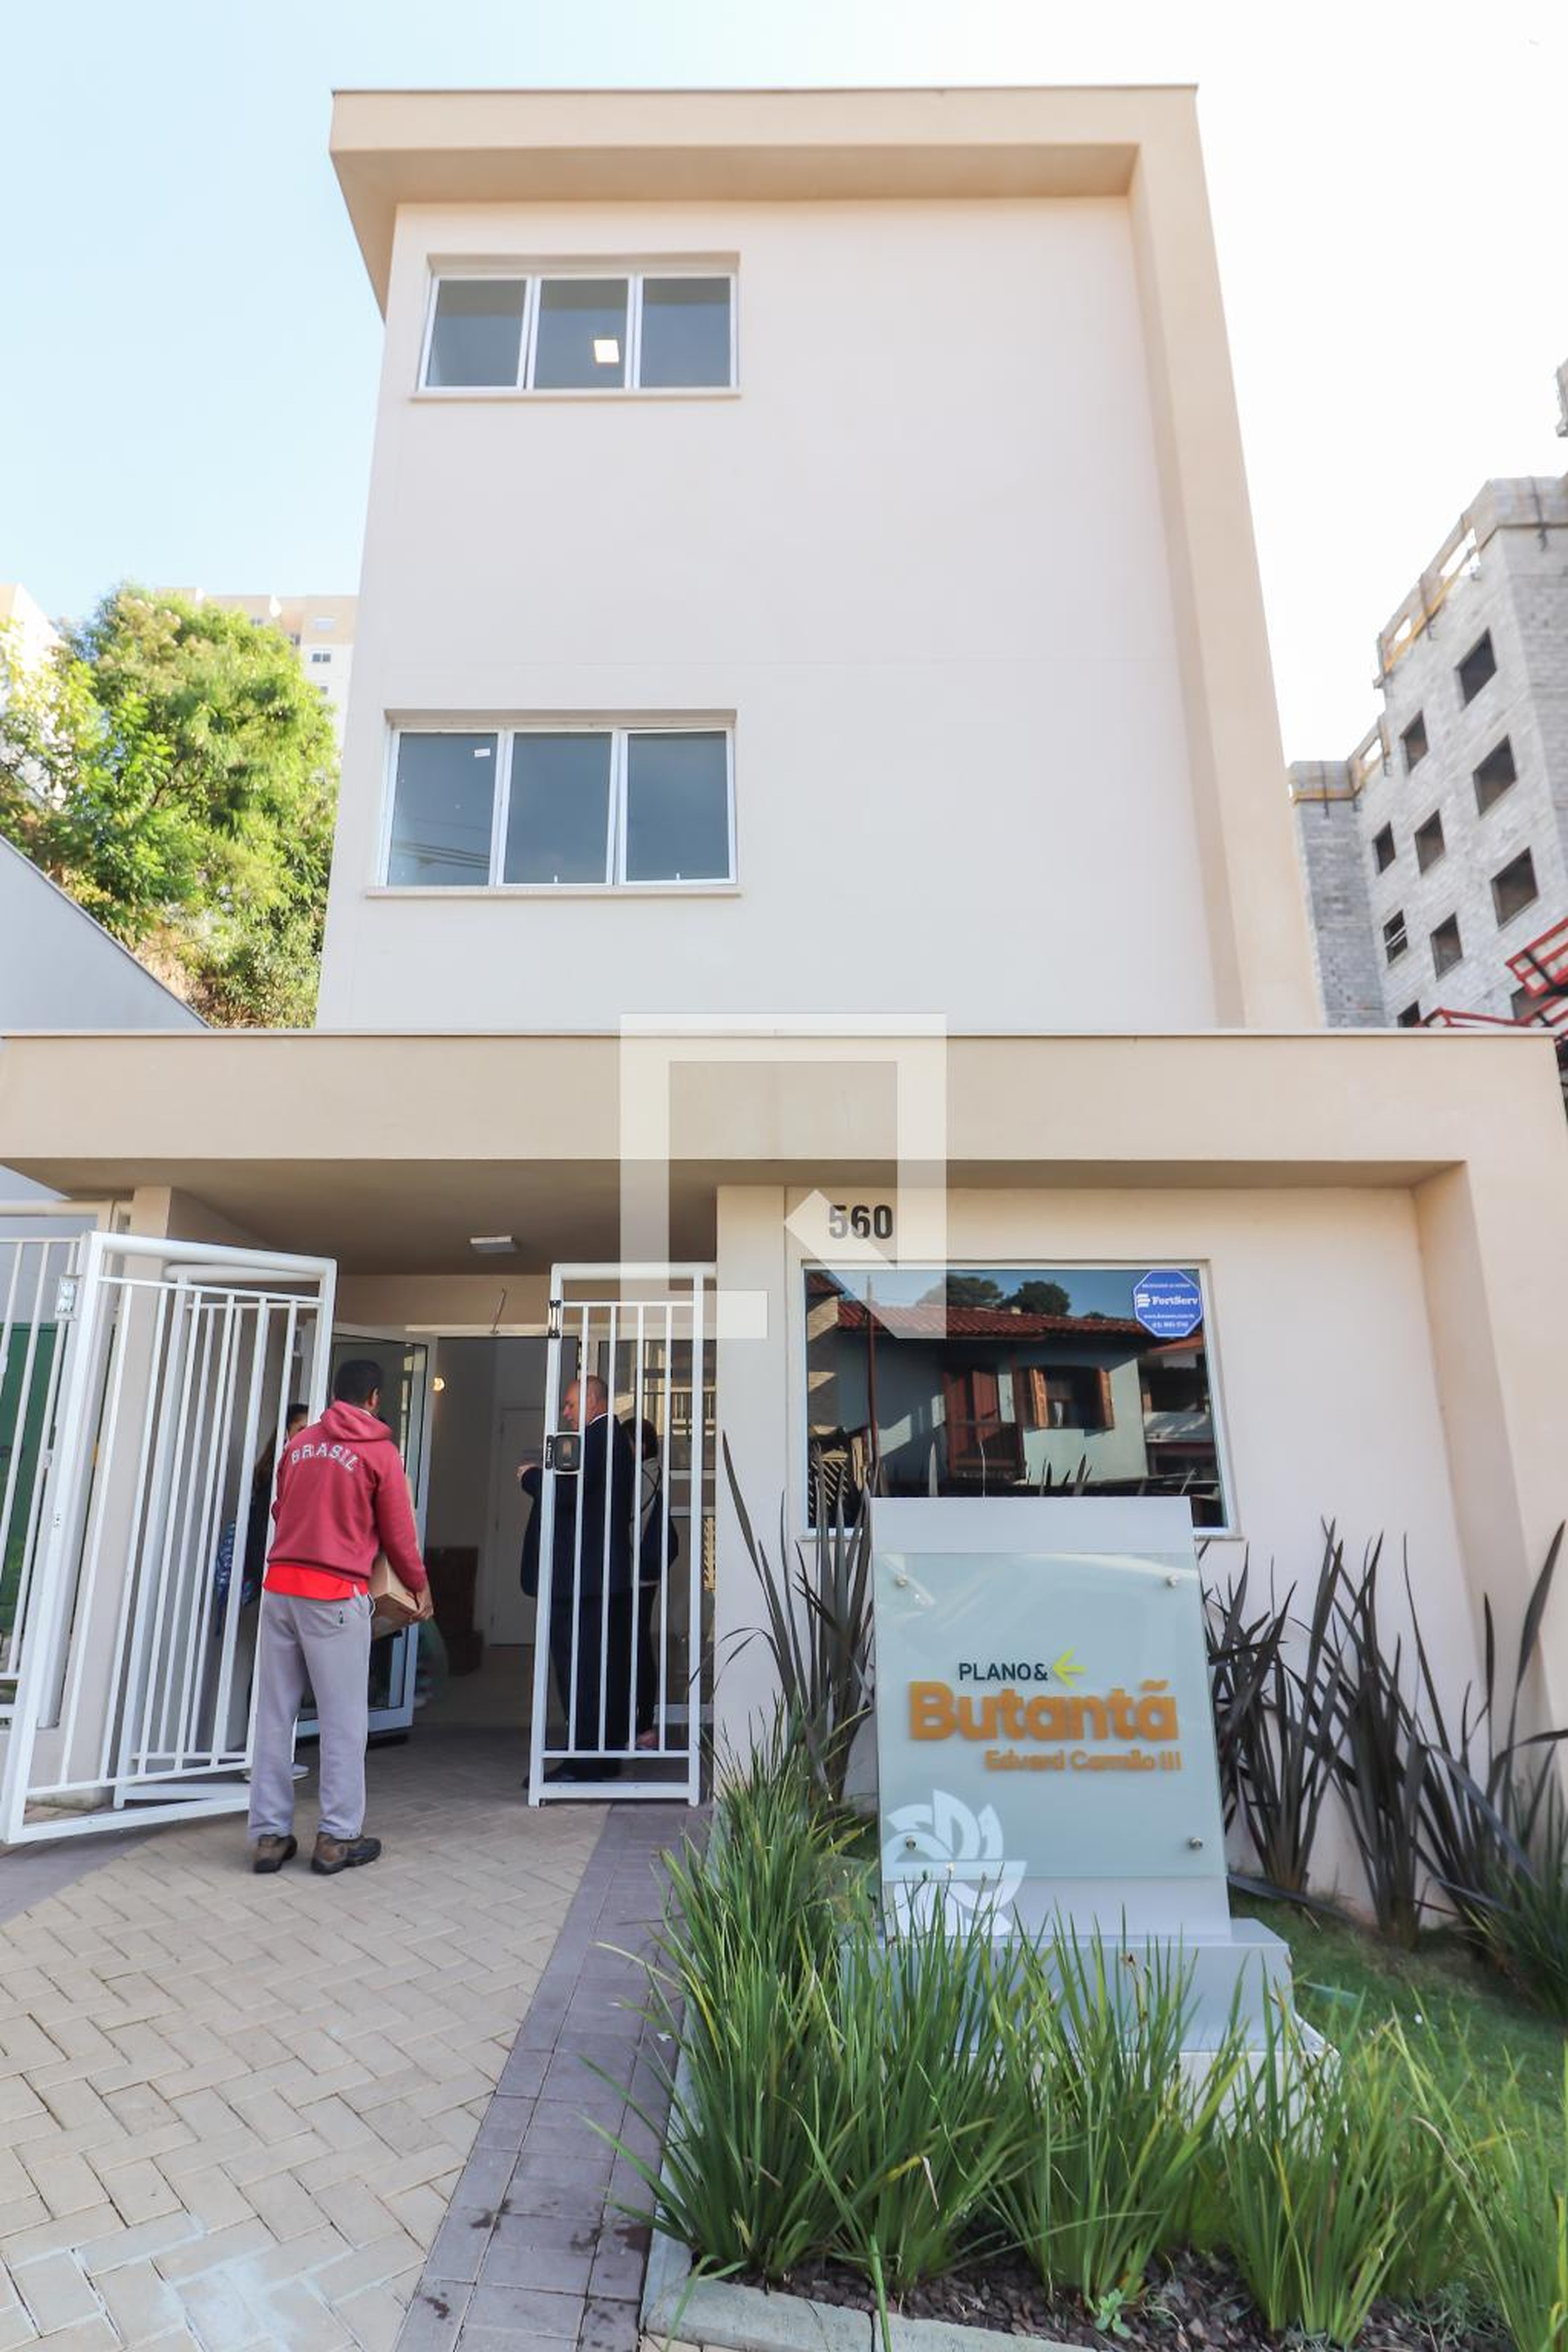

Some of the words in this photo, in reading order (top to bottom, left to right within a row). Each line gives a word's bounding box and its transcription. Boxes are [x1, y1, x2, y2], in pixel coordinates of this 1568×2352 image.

[829, 1205, 893, 1239] 560
[291, 1442, 358, 1471] BRASIL
[909, 1679, 1178, 1740] Butantã
